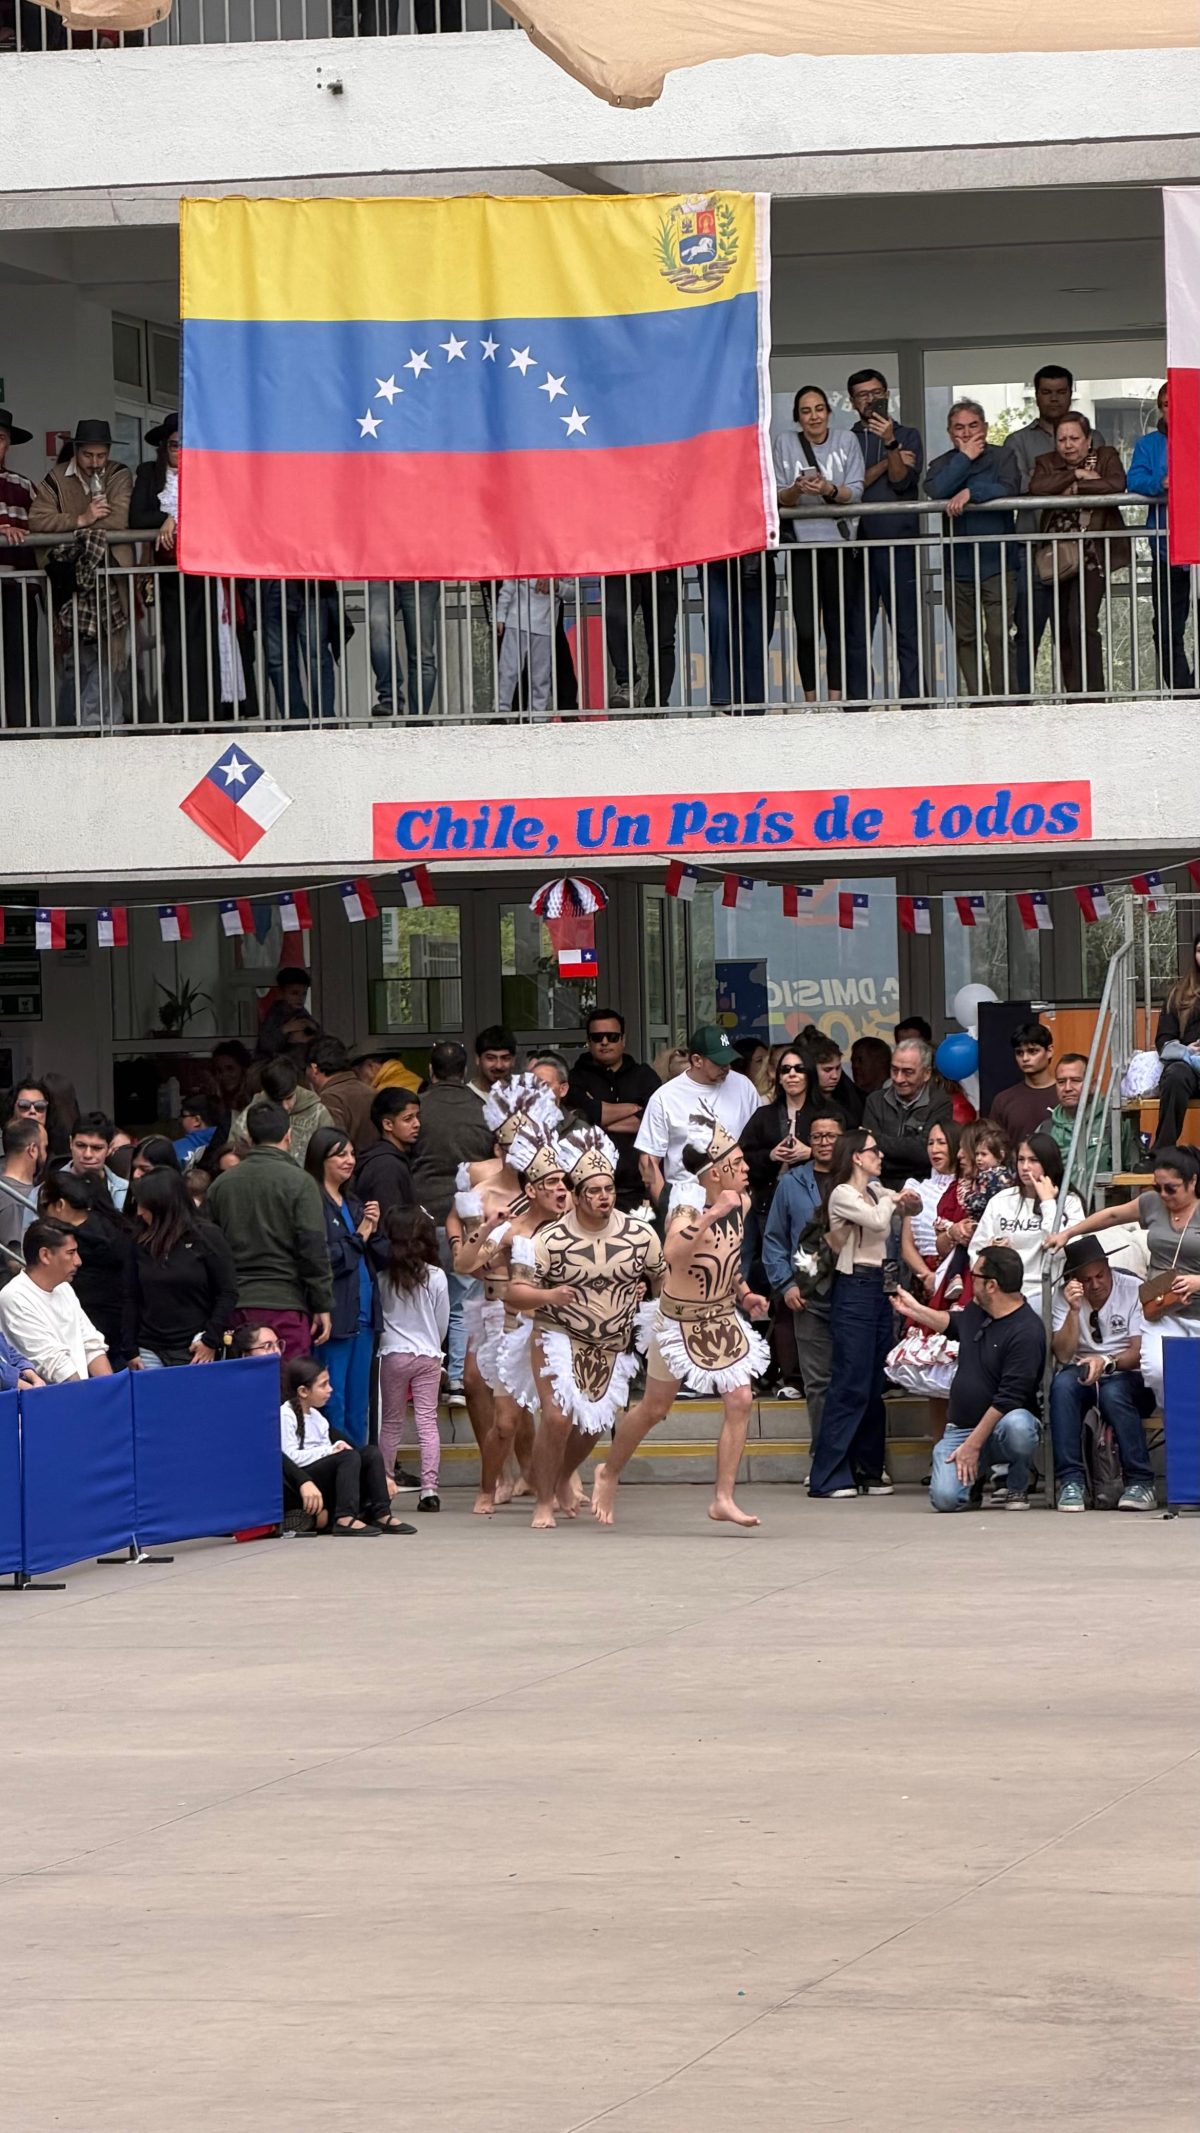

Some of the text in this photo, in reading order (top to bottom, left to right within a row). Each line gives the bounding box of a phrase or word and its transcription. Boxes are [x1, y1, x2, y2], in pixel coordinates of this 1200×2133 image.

[396, 790, 1081, 855] Chile, Un País de todos
